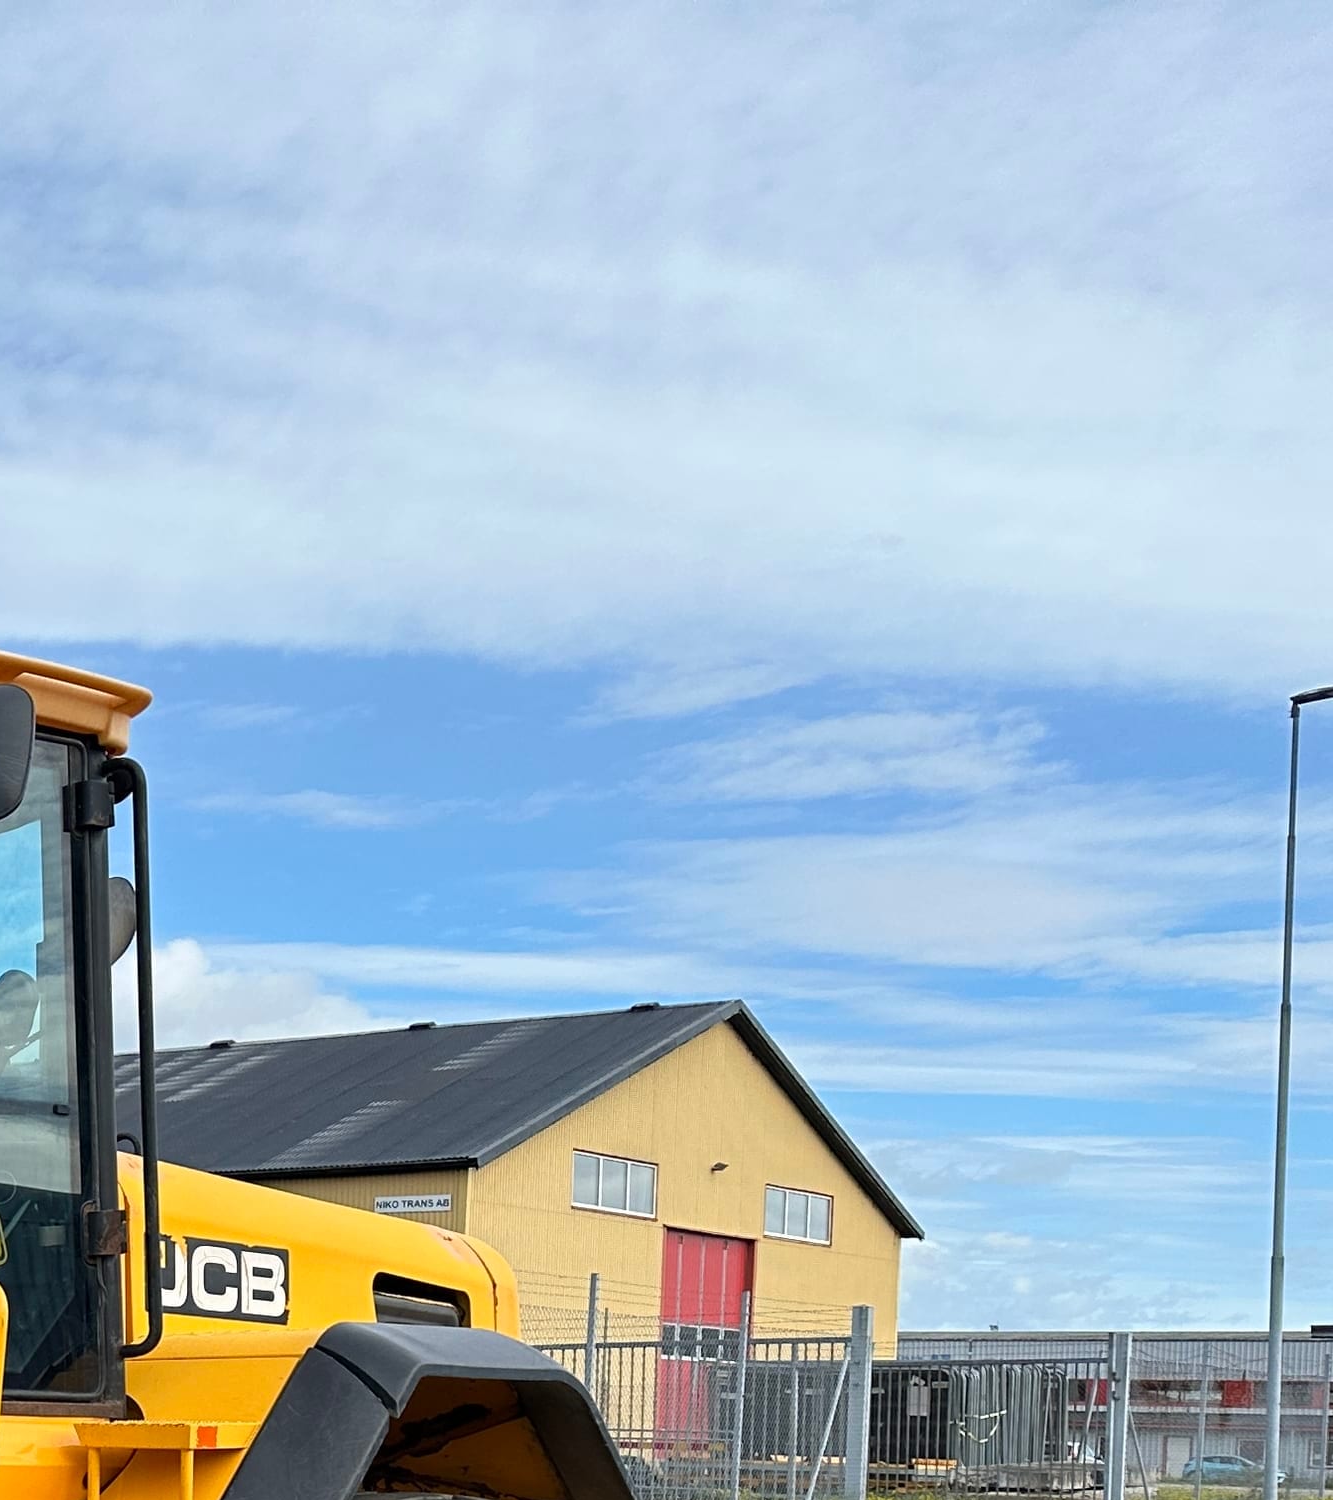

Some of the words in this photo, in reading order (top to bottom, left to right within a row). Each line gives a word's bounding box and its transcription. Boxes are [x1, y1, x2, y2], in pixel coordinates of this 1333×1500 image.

[376, 1200, 399, 1209] NIKO
[401, 1199, 433, 1208] TRANS
[436, 1198, 450, 1207] AB
